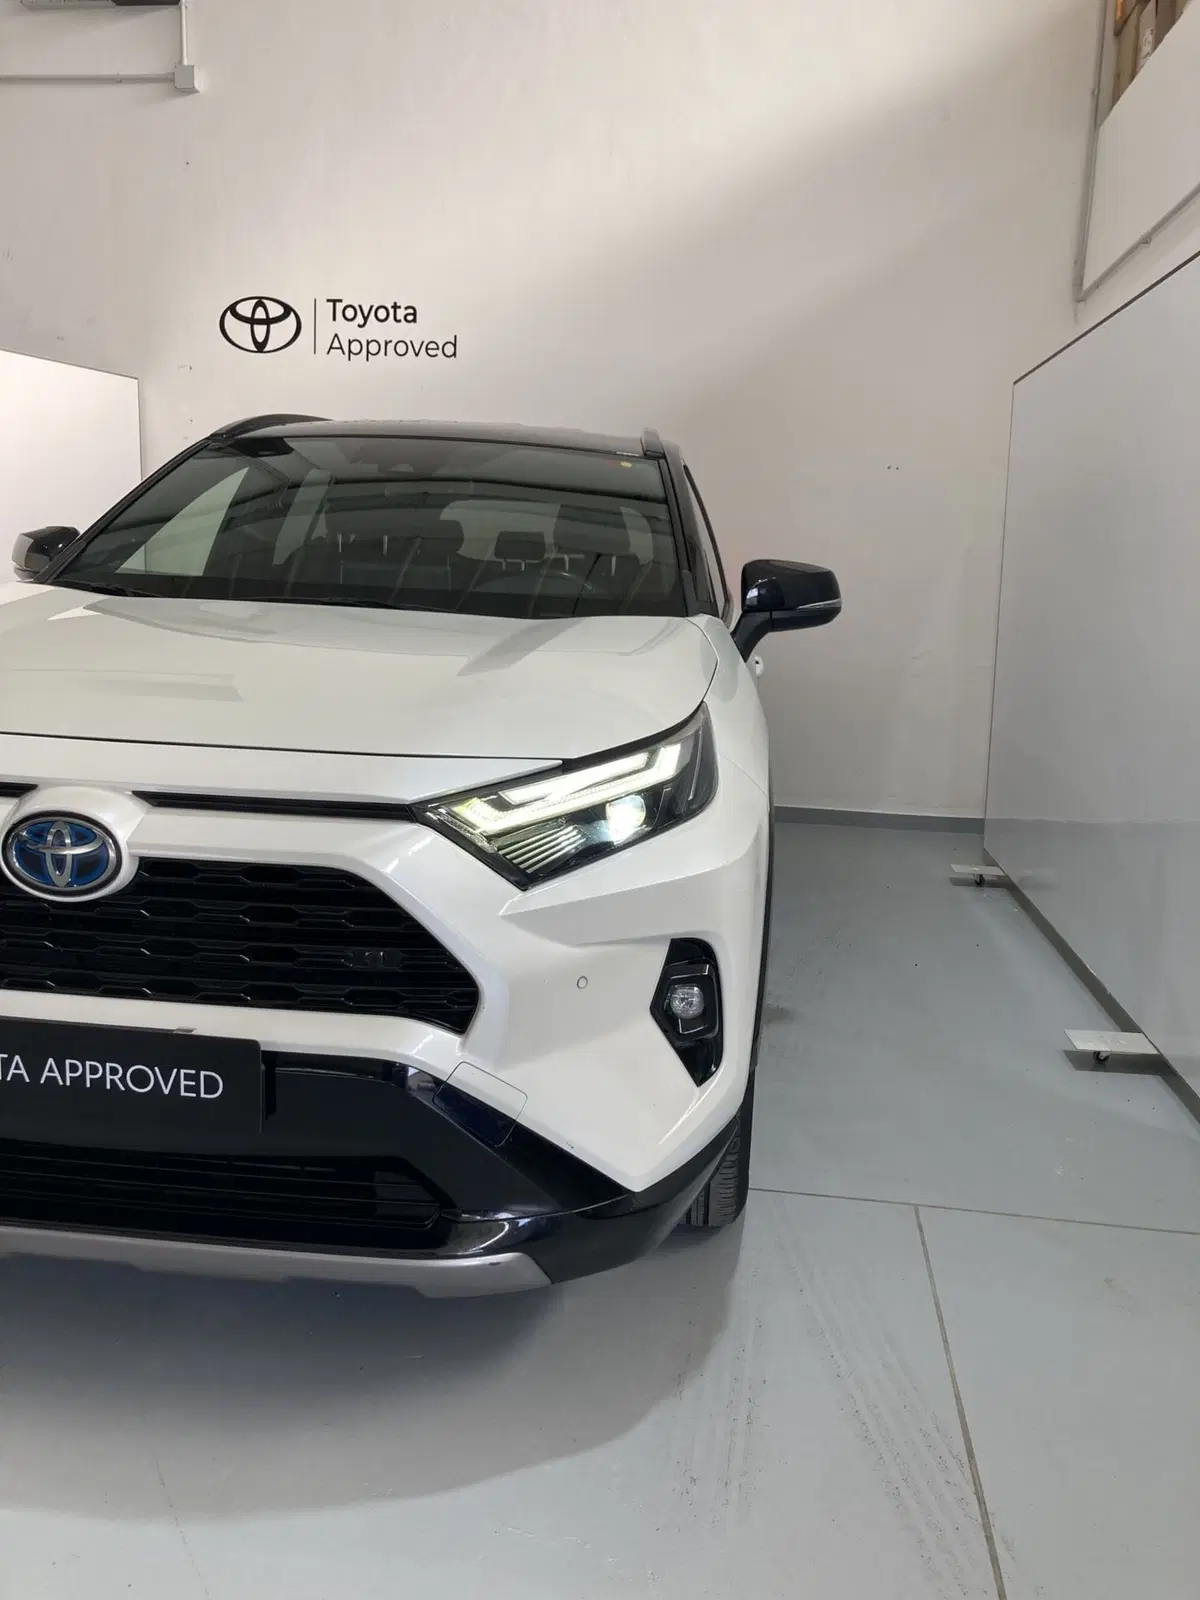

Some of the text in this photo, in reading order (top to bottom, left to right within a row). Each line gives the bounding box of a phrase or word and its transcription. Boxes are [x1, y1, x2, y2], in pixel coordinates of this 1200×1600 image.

[326, 298, 418, 328] Toyota
[326, 333, 458, 362] Approved
[40, 1057, 224, 1099] APPROVED
